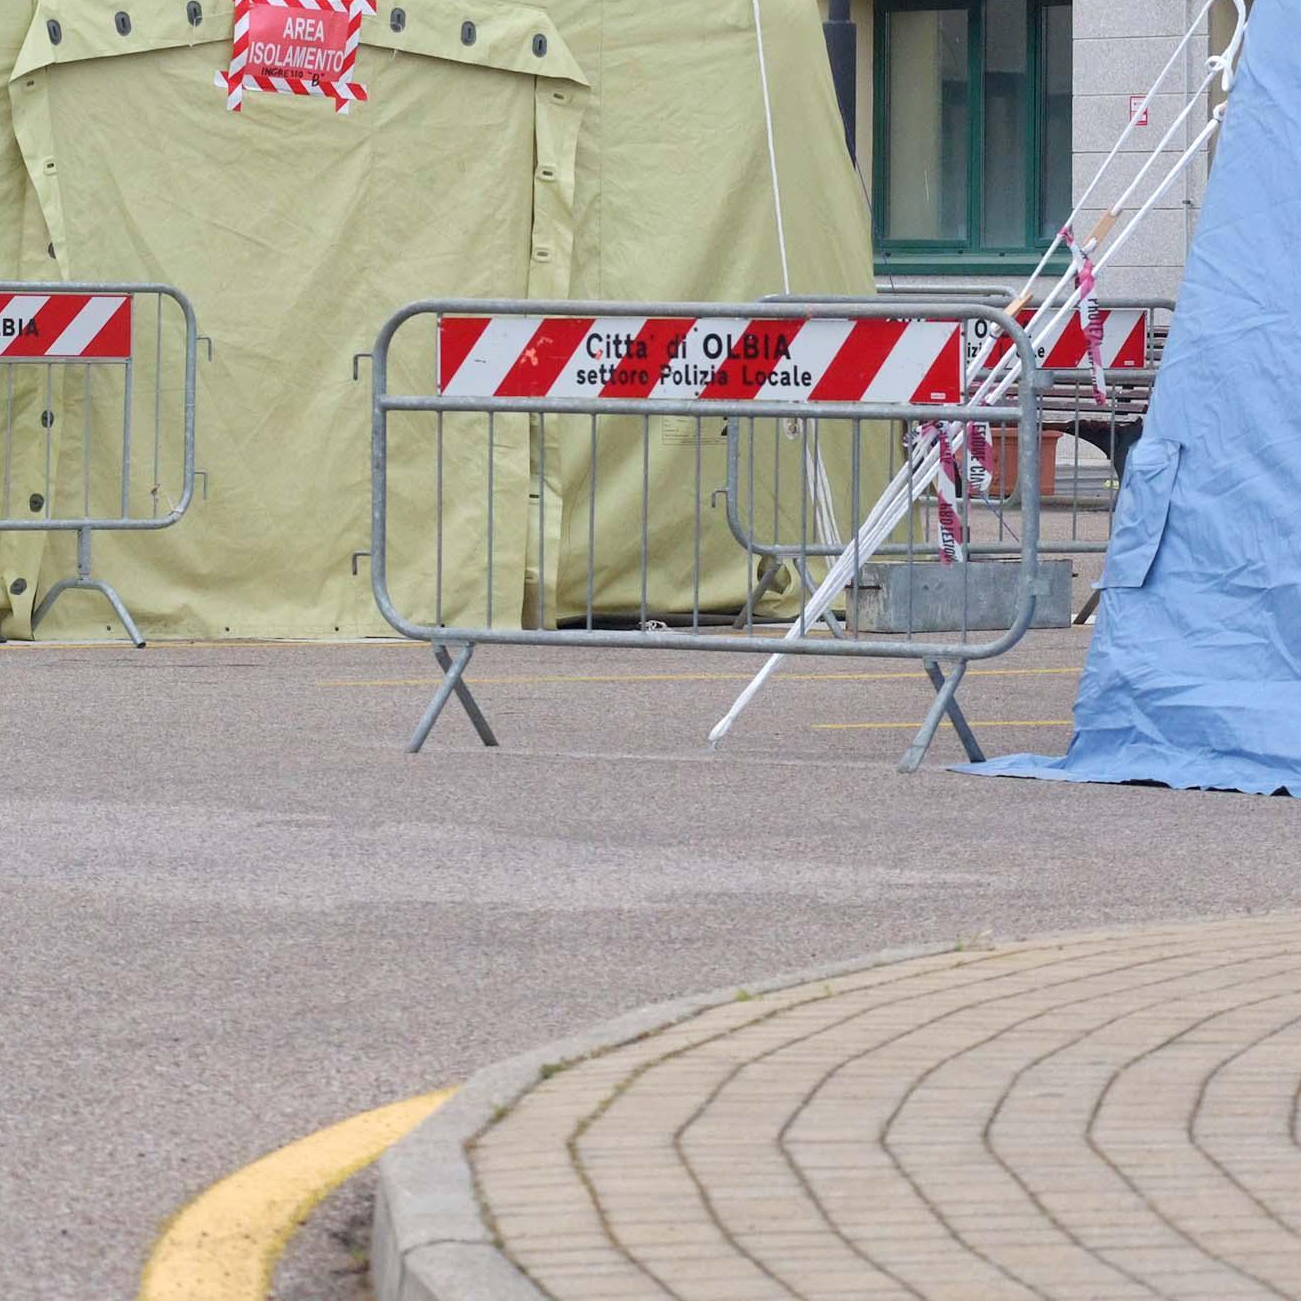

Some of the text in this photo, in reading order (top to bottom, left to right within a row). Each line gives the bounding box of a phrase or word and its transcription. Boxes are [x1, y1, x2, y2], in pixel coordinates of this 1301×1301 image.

[283, 17, 325, 42] AREA
[250, 42, 344, 72] ISOLAMENTO
[667, 333, 687, 360] di
[702, 333, 792, 360] OLBIA
[576, 364, 813, 387] settore Polizia Locale
